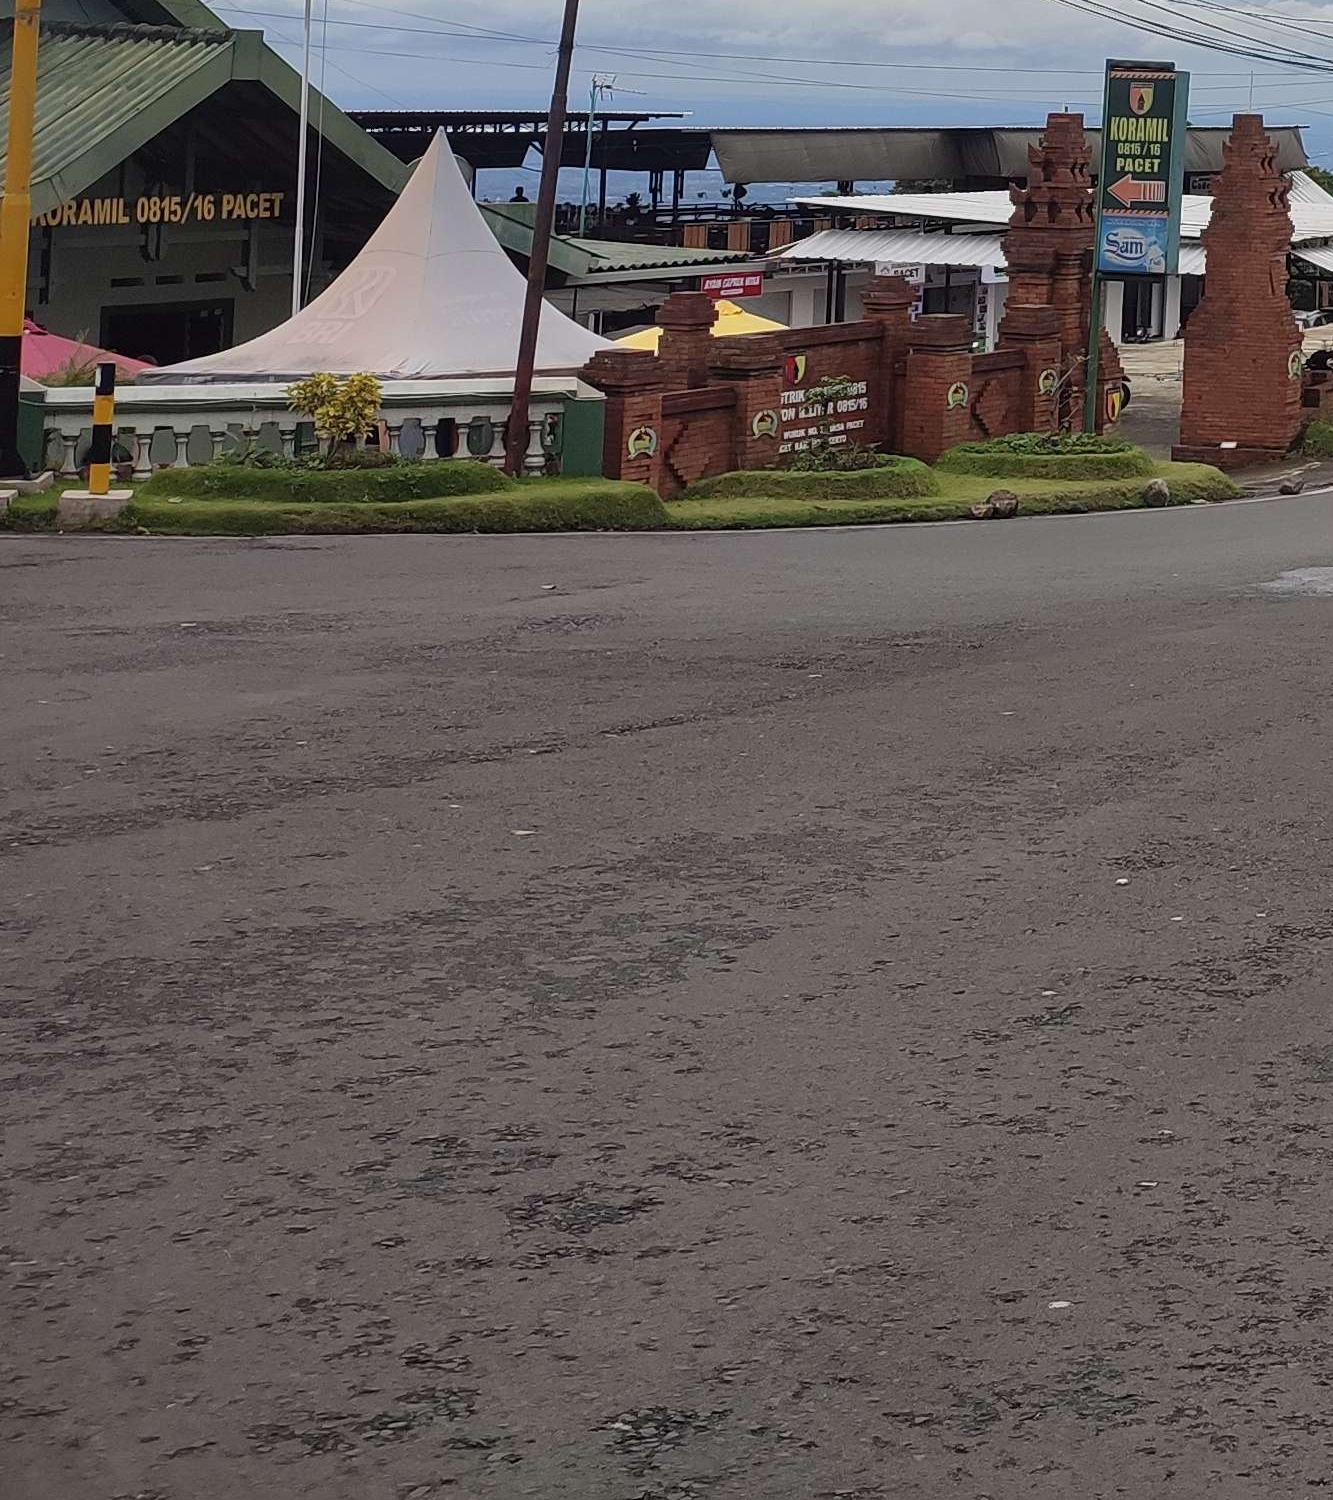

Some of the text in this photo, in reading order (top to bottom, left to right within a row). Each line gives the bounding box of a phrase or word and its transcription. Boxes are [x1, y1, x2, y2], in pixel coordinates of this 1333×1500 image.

[1110, 116, 1169, 142] KORAMIL
[1116, 157, 1161, 173] PACET
[136, 191, 215, 225] 0815/16
[221, 192, 285, 220] PACET
[1103, 231, 1146, 260] Sam
